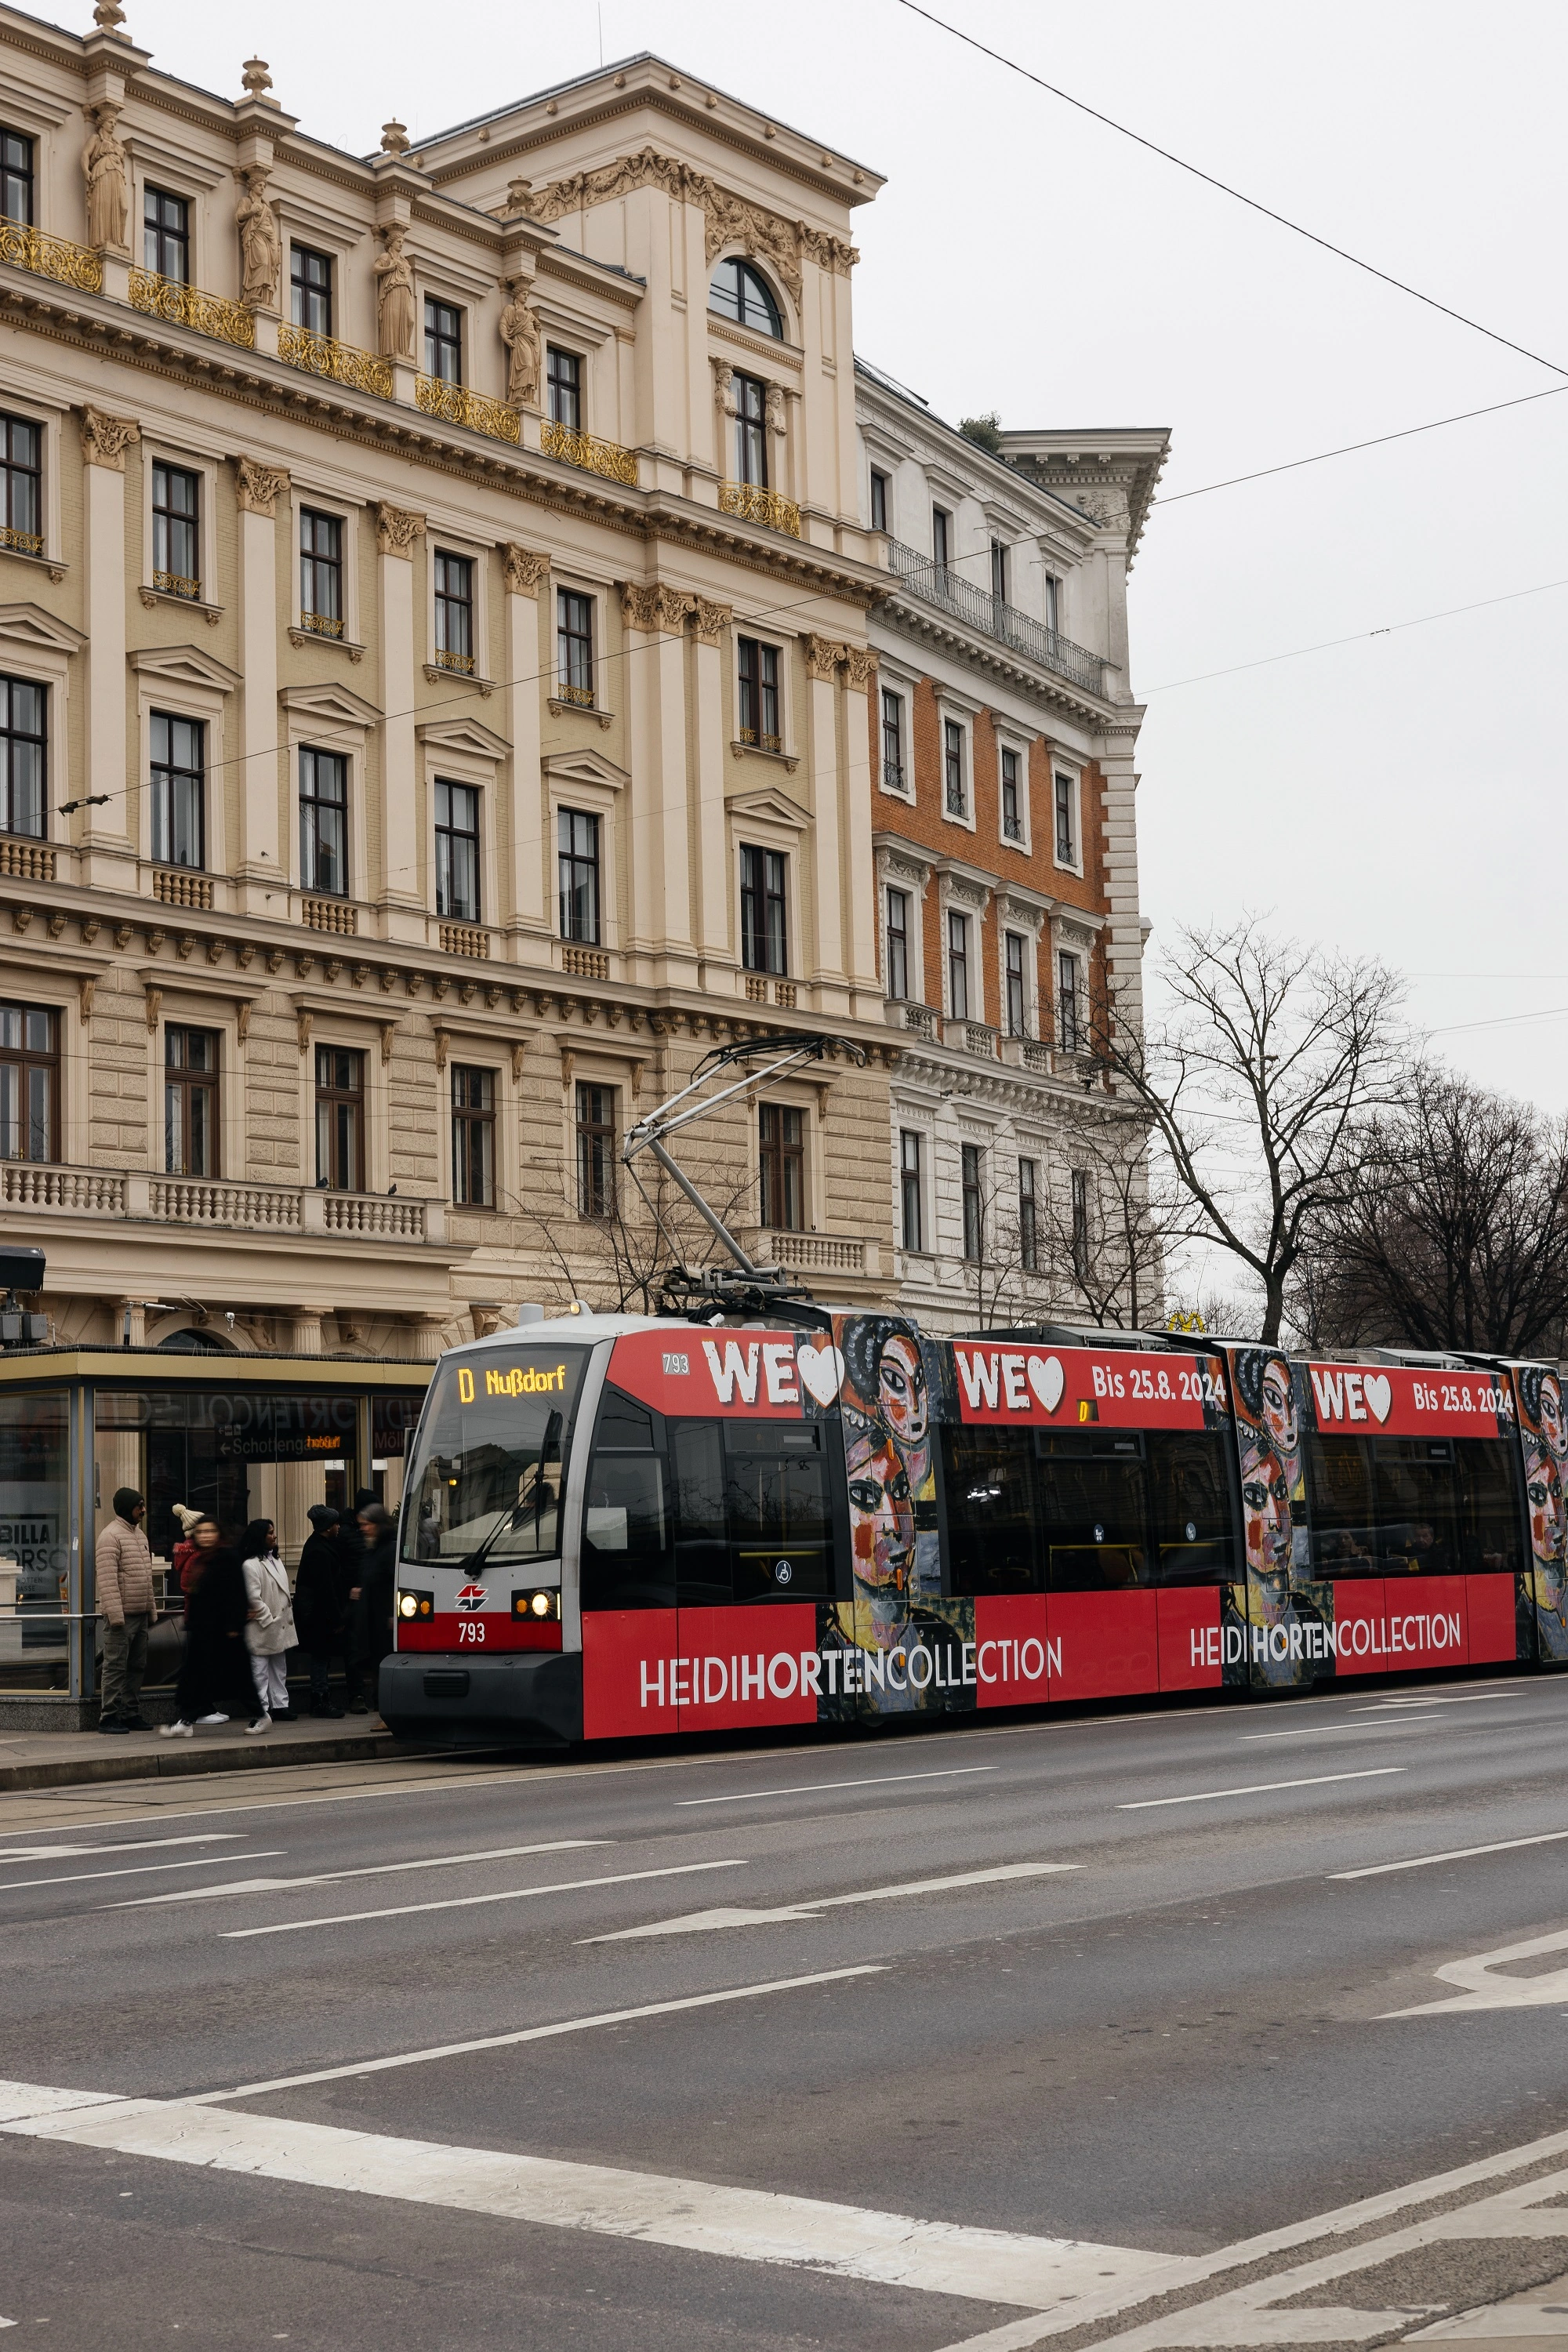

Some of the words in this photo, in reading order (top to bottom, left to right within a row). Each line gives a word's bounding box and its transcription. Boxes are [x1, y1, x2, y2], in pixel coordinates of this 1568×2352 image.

[662, 1353, 689, 1374] 793
[701, 1341, 799, 1403] WE
[955, 1351, 1030, 1409] WE
[458, 1368, 475, 1403] D
[485, 1365, 565, 1398] Nußdorf
[1091, 1366, 1126, 1398] Bis
[1129, 1369, 1176, 1400] 25.8.
[1178, 1371, 1227, 1402] 2024
[1310, 1370, 1367, 1420] WE
[1413, 1382, 1439, 1410] Bis
[1440, 1385, 1476, 1412] 25.8.
[1477, 1387, 1514, 1414] 2024
[1079, 1401, 1089, 1422] D
[0, 1524, 51, 1544] BILLA
[458, 1622, 485, 1642] 793
